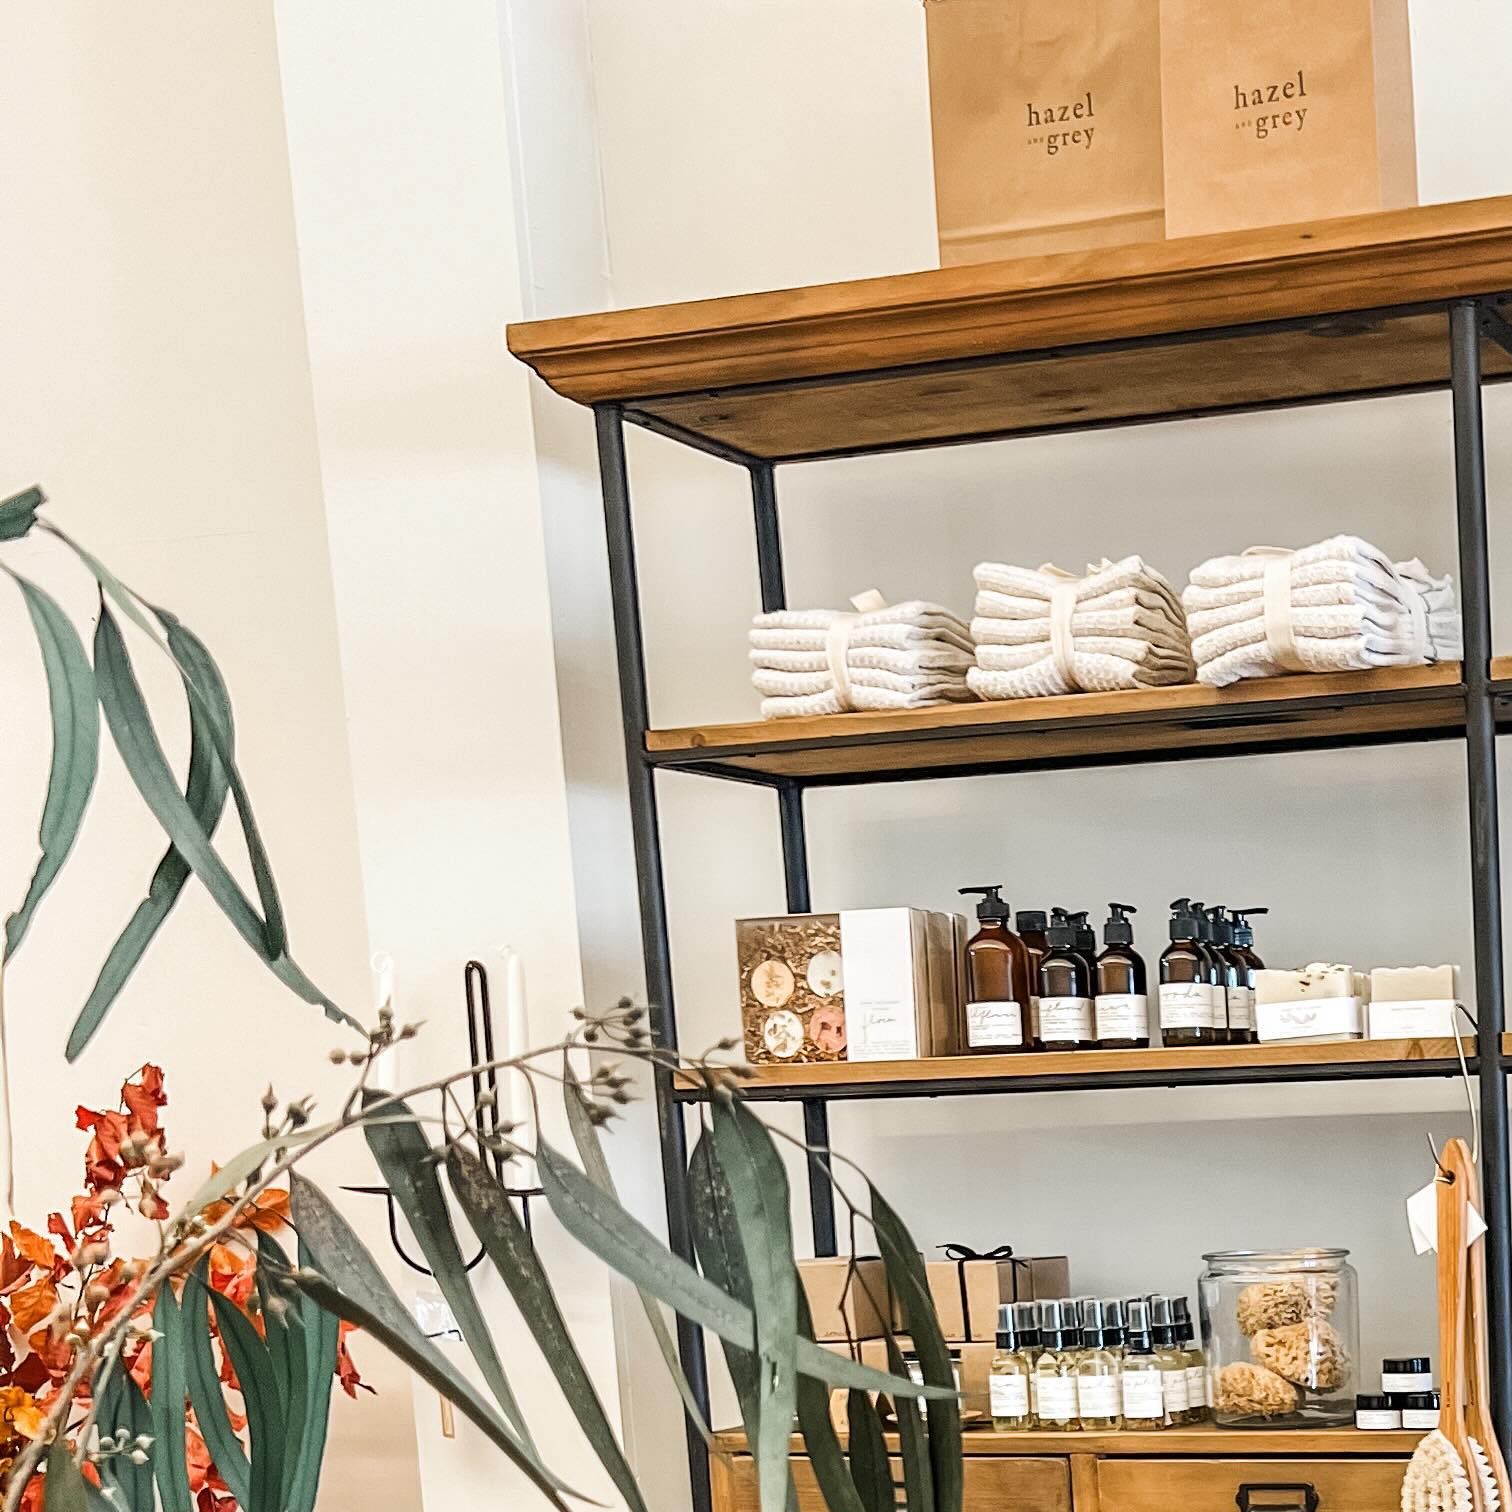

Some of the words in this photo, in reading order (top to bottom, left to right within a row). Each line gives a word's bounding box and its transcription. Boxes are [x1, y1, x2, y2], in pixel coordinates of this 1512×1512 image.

[1232, 69, 1306, 110] hazel
[1026, 91, 1095, 127] hazel
[1256, 108, 1308, 139] grey
[1047, 127, 1095, 156] grey
